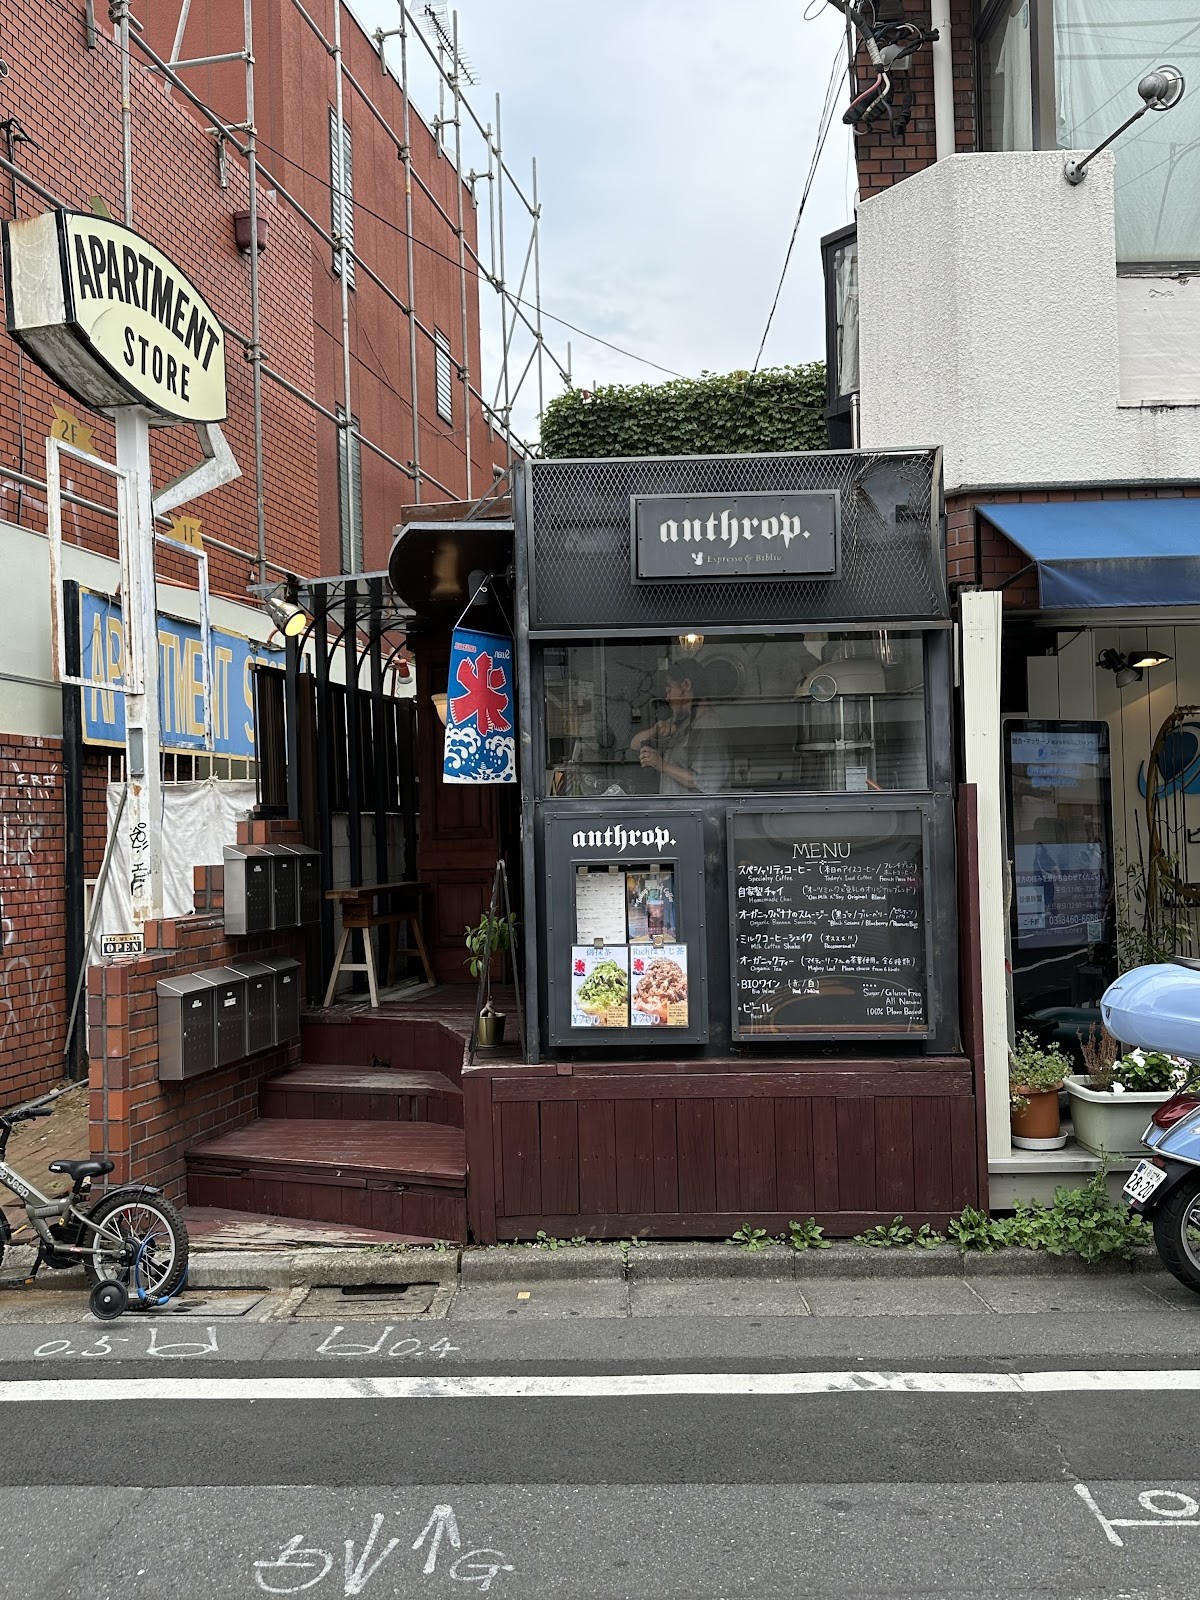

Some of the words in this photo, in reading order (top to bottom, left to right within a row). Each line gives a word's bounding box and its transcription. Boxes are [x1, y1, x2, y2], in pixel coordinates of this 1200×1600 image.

[74, 233, 220, 372] APARTMENT
[123, 326, 190, 402] STORE
[60, 419, 78, 443] 2F
[182, 524, 195, 543] 1F
[659, 509, 811, 549] anthrop.
[707, 554, 743, 566] Espresso
[572, 824, 676, 854] anthrop.
[791, 842, 851, 860] MENU
[738, 864, 812, 876] スペシャリティコーヒー
[738, 886, 784, 898] 自家製チャイ
[738, 908, 829, 920] オーガニックバナナのスムージー
[740, 933, 813, 944] ミルクコーヒーシェイク
[106, 942, 139, 953] OPEN
[740, 955, 795, 966] オーガニックティー
[741, 980, 780, 989] BIOワイン
[743, 1002, 774, 1013] ビール
[866, 1008, 883, 1016] 100%
[7, 1176, 30, 1199] Jeep
[33, 1336, 128, 1358] 0.5
[389, 1337, 460, 1359] 0.4
